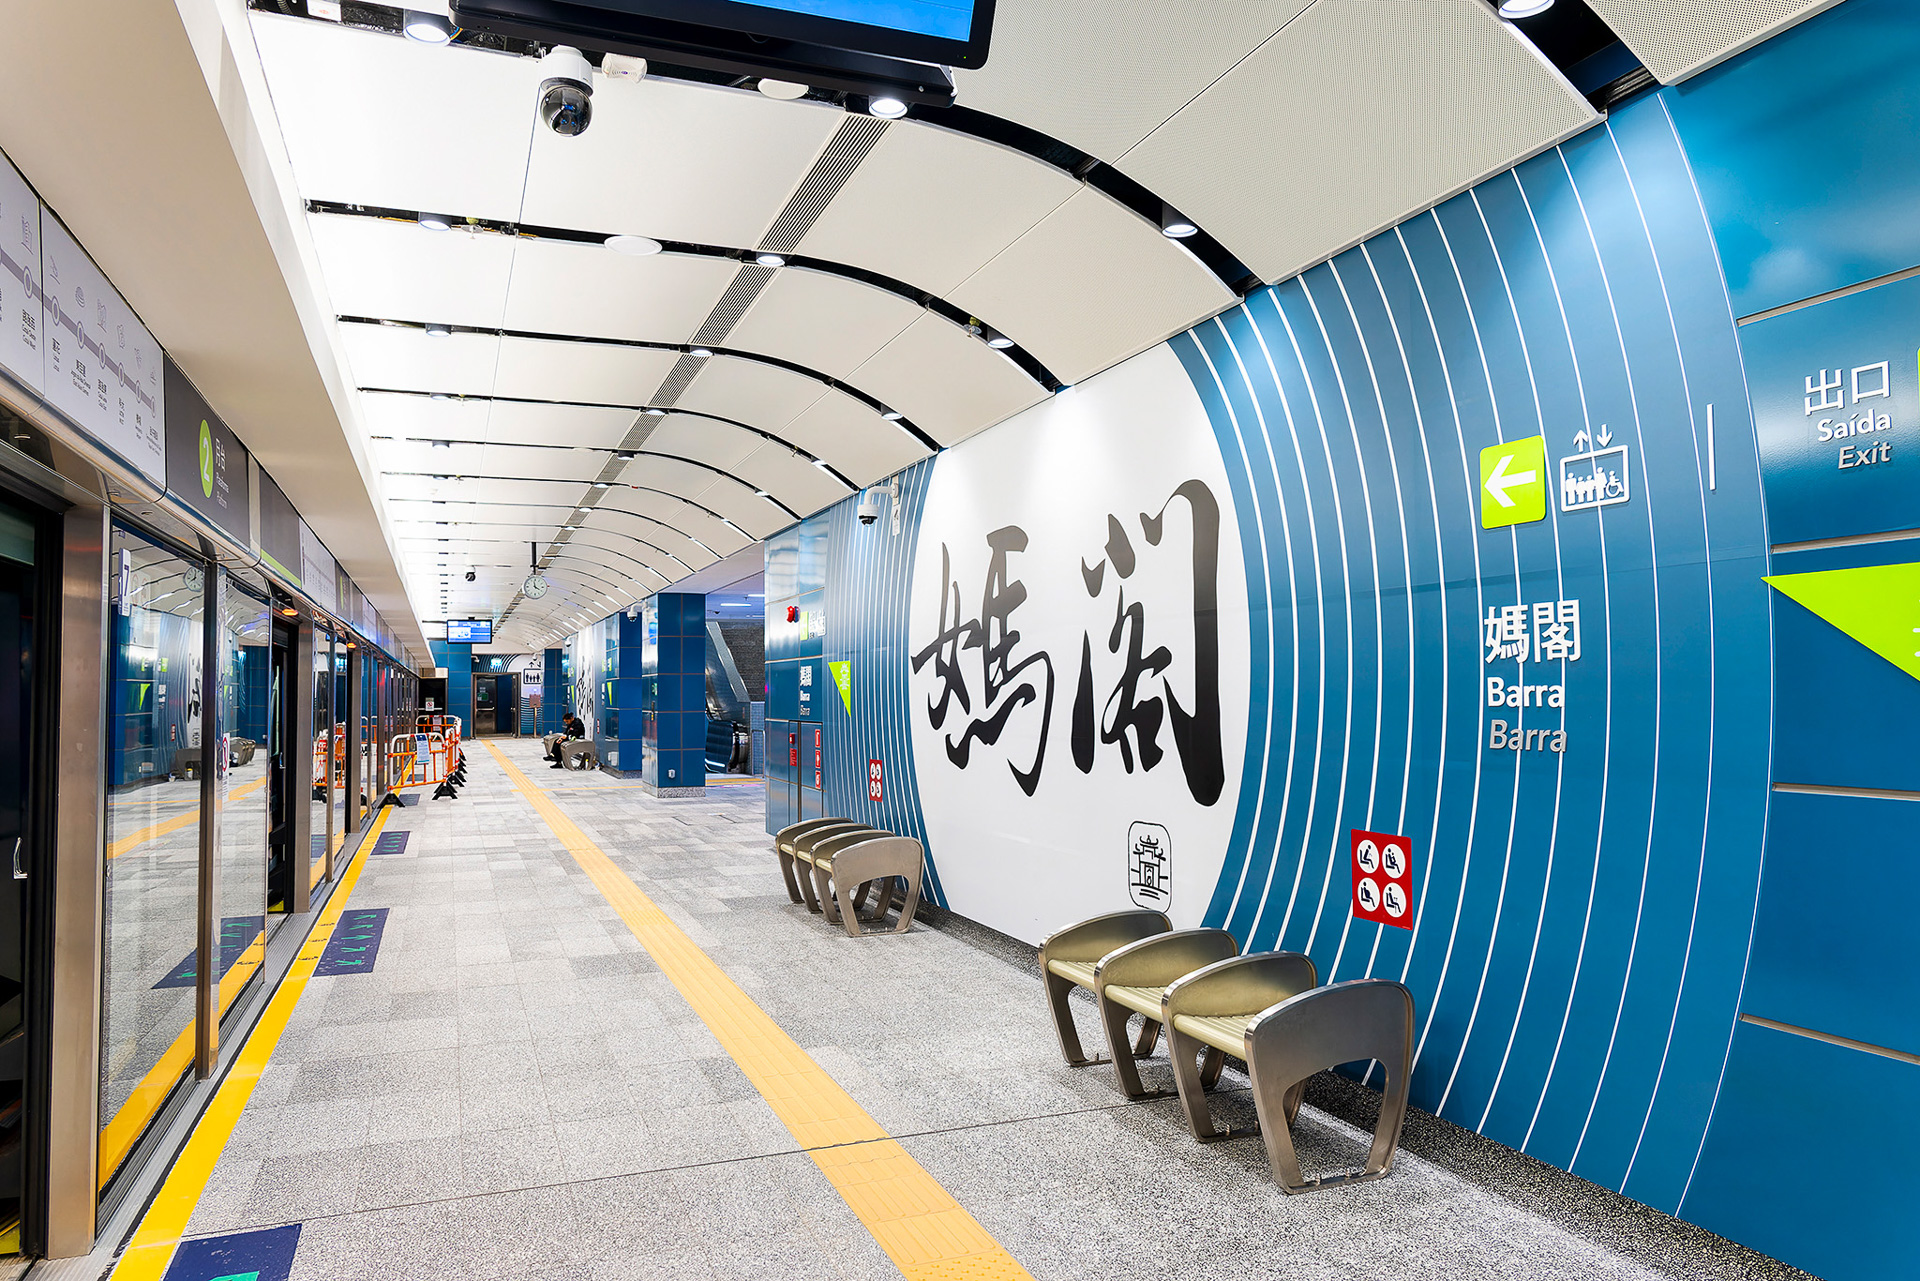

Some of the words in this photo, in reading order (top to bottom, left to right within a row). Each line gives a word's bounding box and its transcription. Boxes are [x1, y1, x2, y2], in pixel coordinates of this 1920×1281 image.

[1804, 360, 1891, 416] 出口
[1817, 409, 1892, 442] Saída
[203, 437, 210, 482] 2
[1838, 441, 1893, 471] Exit
[911, 479, 1225, 806] 媽閣
[1484, 599, 1582, 664] 媽閣
[1487, 677, 1565, 708] Barra
[1489, 719, 1568, 753] Barra
